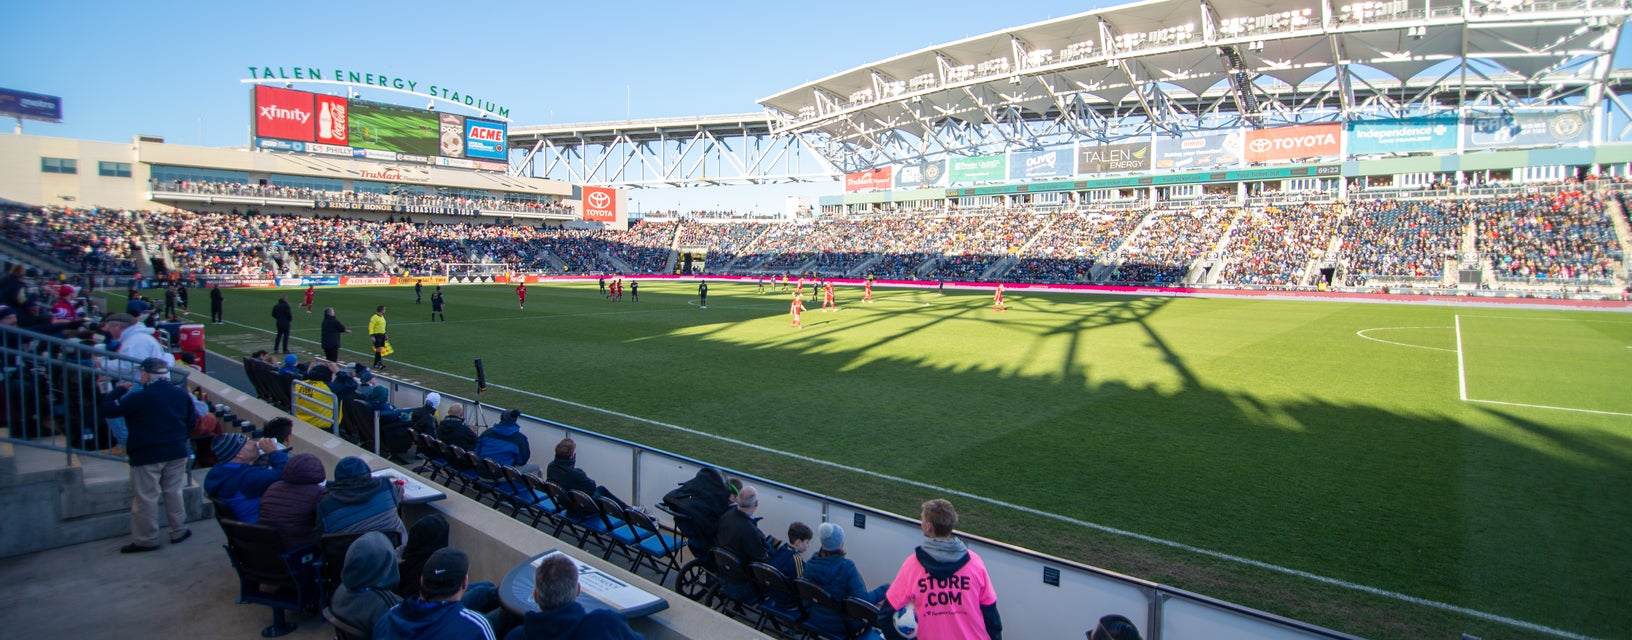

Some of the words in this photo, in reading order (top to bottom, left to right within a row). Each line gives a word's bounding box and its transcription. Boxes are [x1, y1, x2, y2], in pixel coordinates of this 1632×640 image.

[248, 66, 322, 80] TALEN
[335, 70, 417, 92] ENERGY
[429, 85, 510, 118] STADIUM
[260, 105, 311, 124] xfinity
[470, 126, 503, 141] ACME
[1356, 126, 1432, 141] Independence
[1273, 134, 1336, 150] TOYOTA
[1082, 149, 1131, 163] TALEN
[1110, 160, 1144, 169] ENERGY
[1318, 166, 1339, 175] 69:22
[360, 167, 402, 181] TruMark
[586, 209, 613, 217] TOYOTA
[351, 277, 389, 285] ADVOCARE
[918, 575, 970, 593] STORE
[925, 591, 962, 607] .COM
